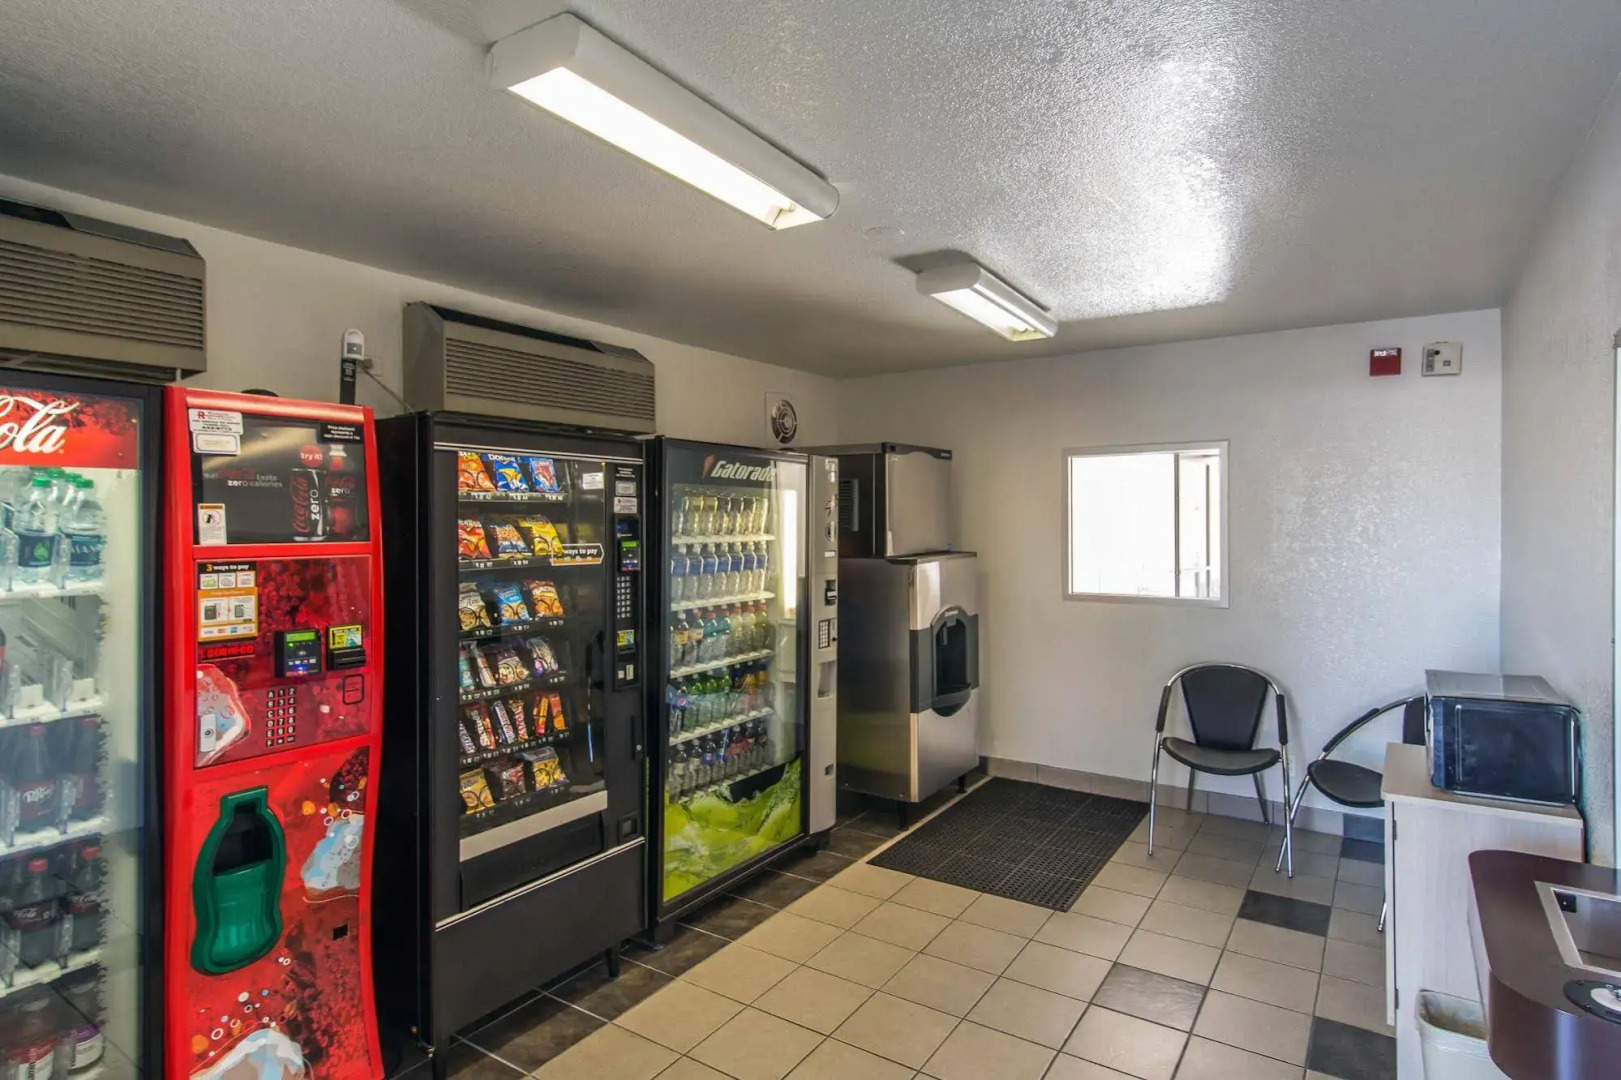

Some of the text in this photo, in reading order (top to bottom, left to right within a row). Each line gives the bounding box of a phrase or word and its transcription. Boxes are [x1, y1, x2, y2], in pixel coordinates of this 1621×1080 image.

[301, 453, 313, 461] try
[310, 489, 320, 521] zero
[587, 548, 598, 556] pay
[206, 564, 213, 572] 3
